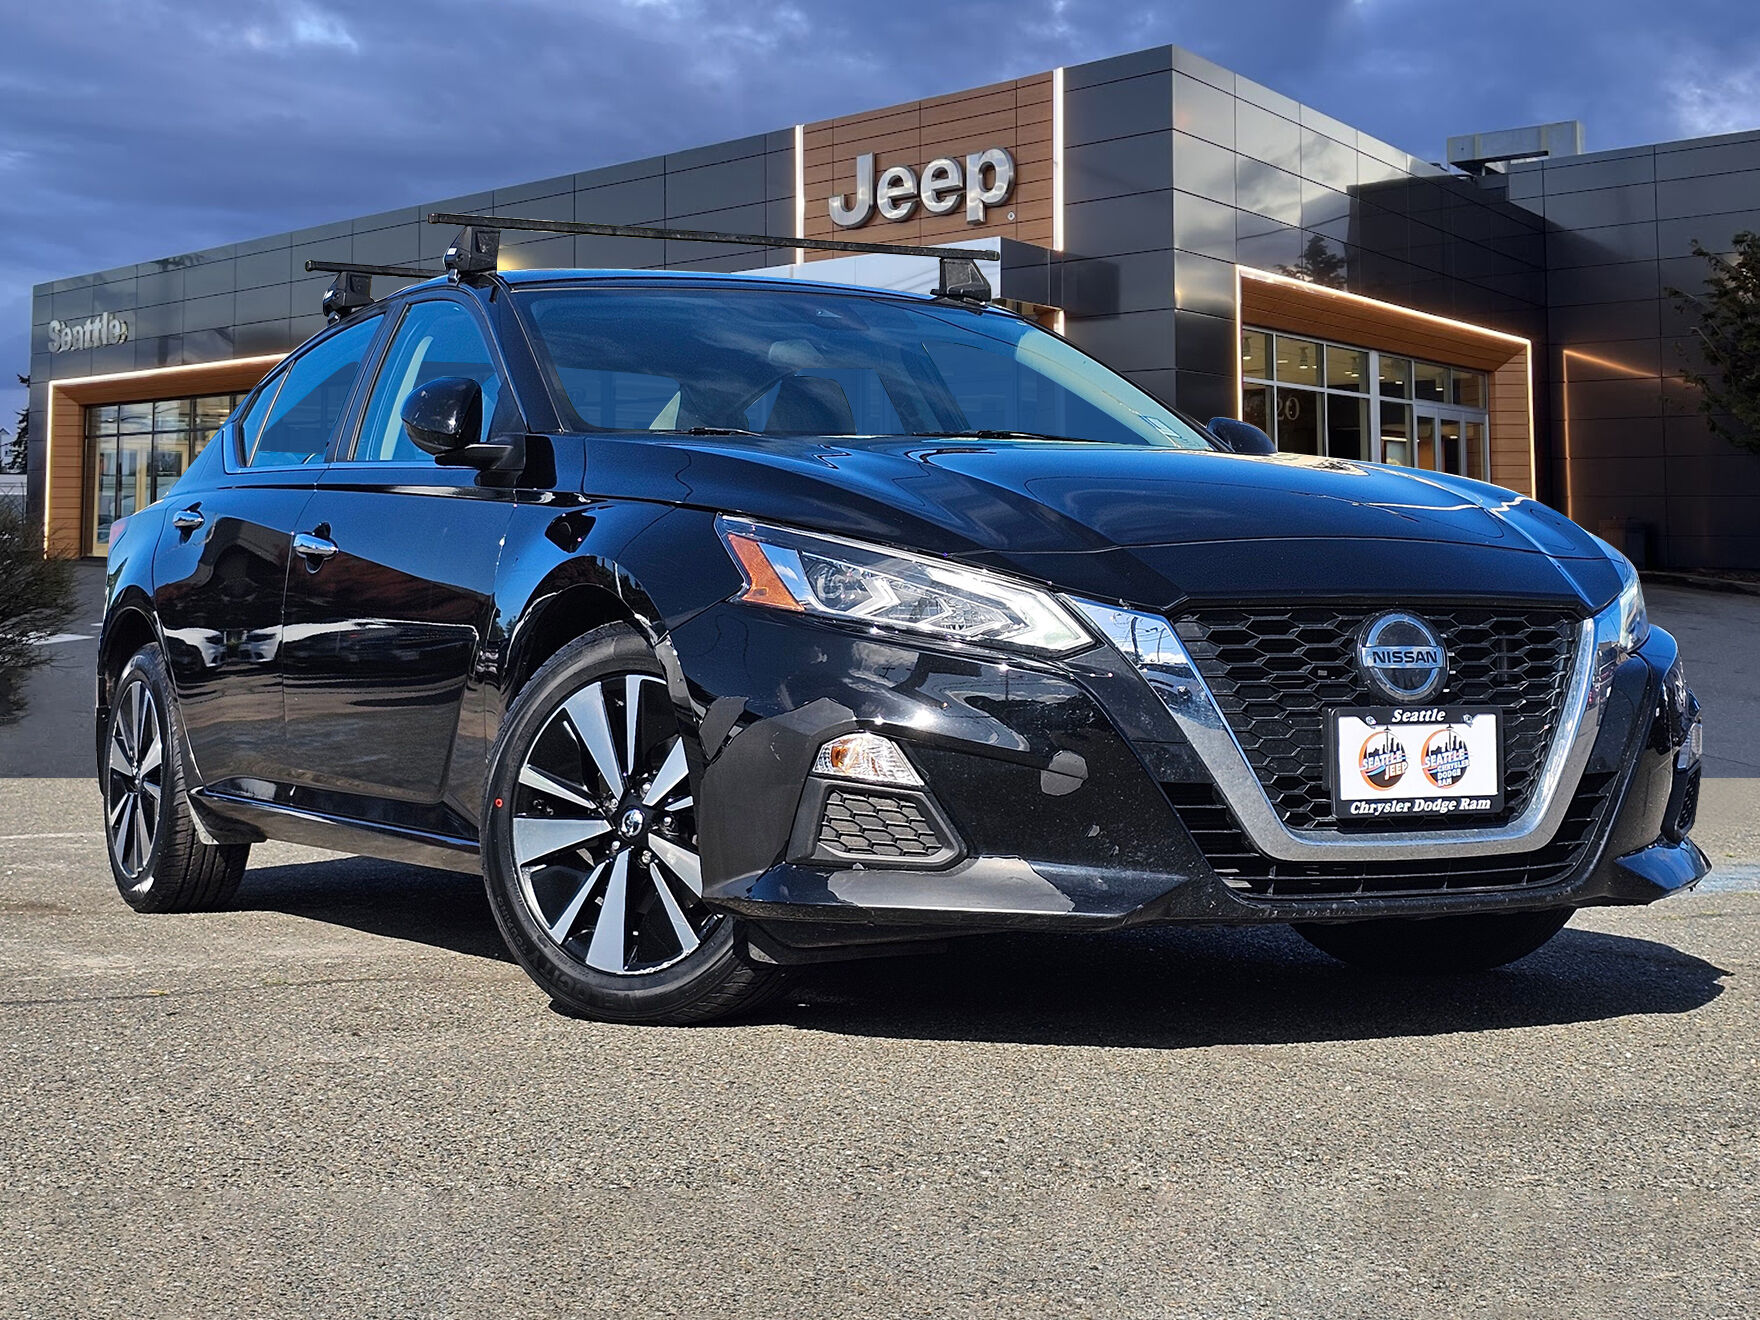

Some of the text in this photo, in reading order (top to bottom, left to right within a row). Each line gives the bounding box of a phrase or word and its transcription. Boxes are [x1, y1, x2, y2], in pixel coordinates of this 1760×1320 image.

[829, 147, 1015, 228] Jeep
[48, 312, 127, 353] Seattle
[1372, 650, 1438, 664] NISSAN
[1391, 709, 1446, 723] Seattle
[1362, 752, 1404, 770] SEATTLE
[1424, 749, 1466, 769] SEATTLE
[1385, 761, 1408, 780] JEEP
[1350, 797, 1491, 815] Chrysler Dodge Ram
